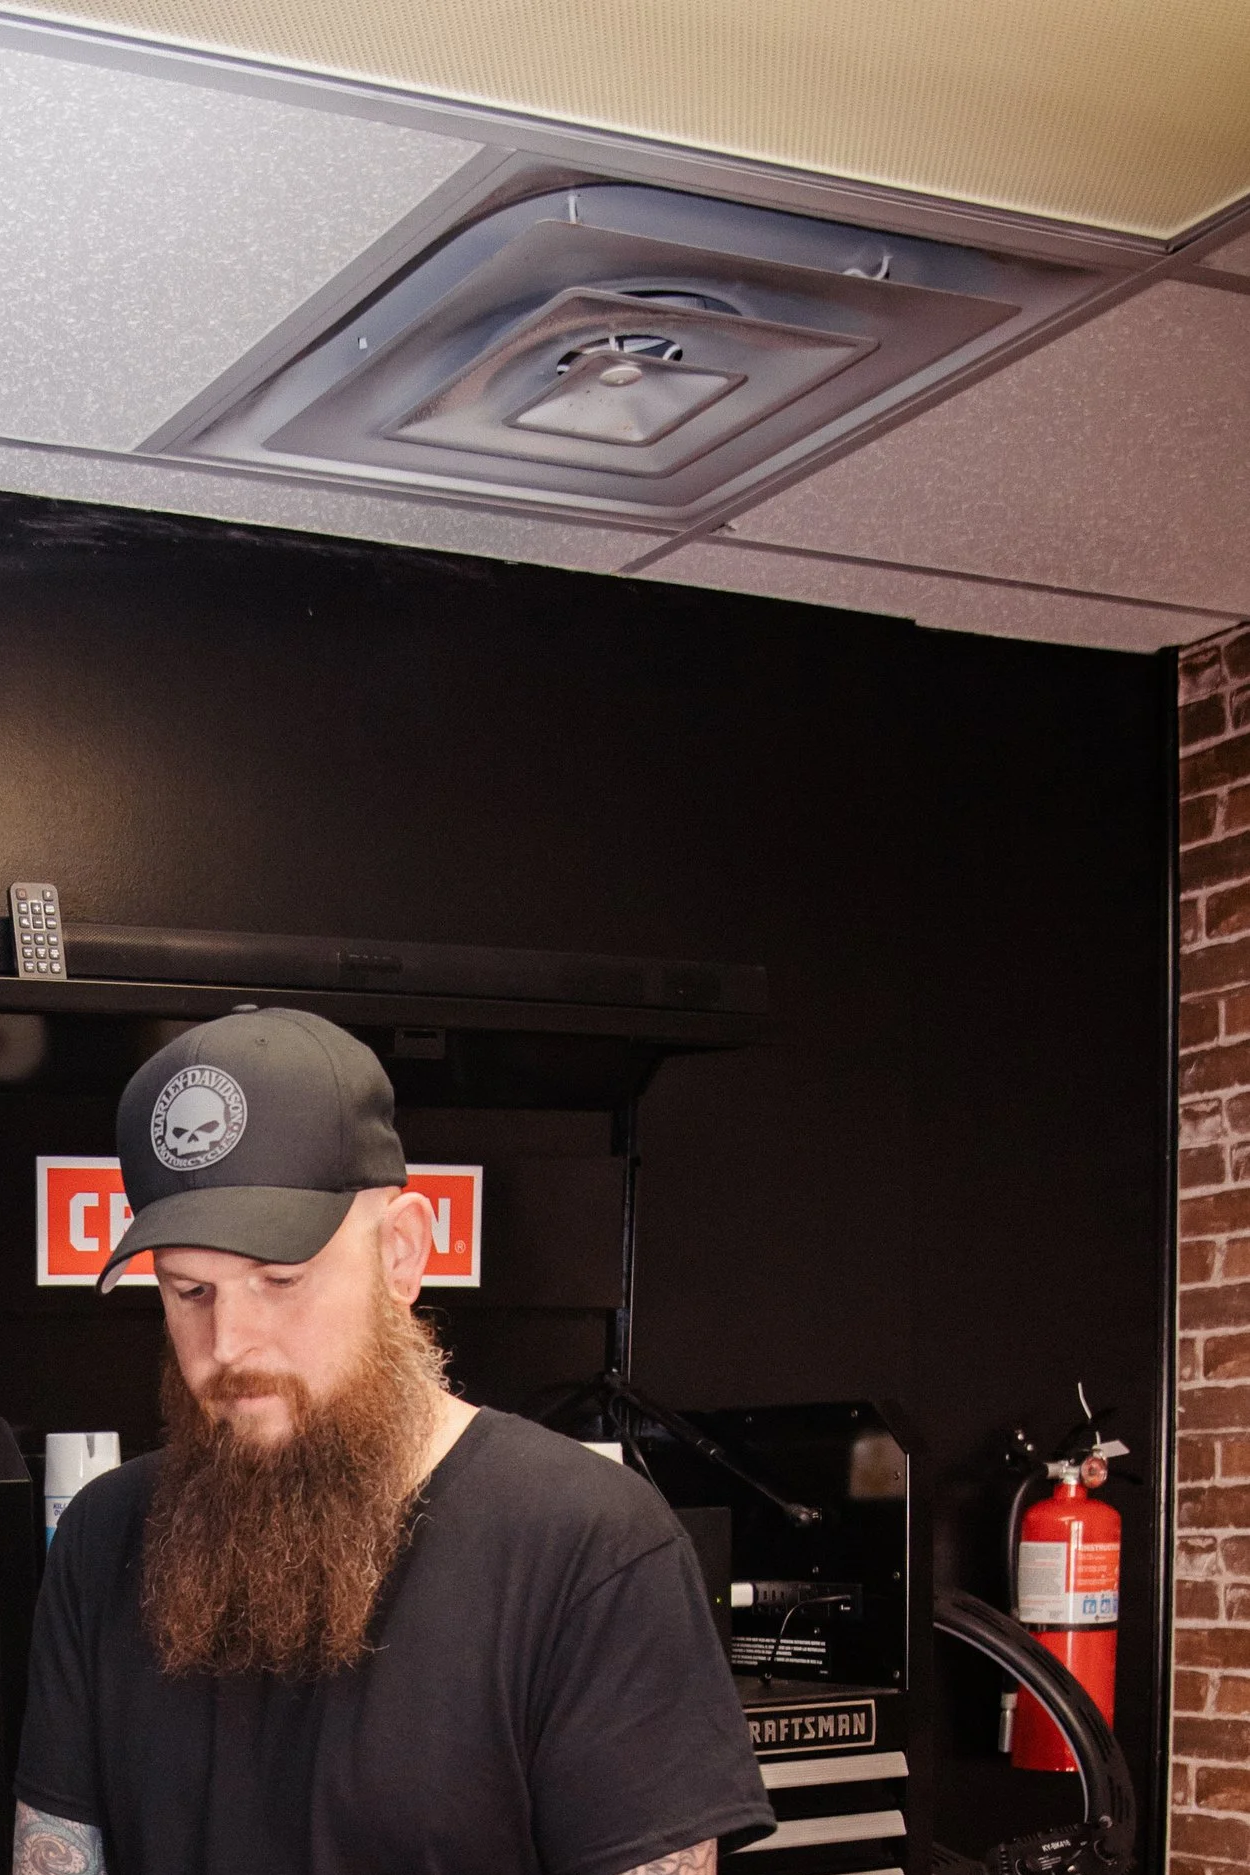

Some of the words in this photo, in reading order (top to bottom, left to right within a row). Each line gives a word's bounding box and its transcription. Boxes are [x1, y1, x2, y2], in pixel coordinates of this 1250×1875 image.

[154, 1069, 243, 1136] HARLEY-DAVIDSON
[157, 1131, 238, 1167] MOTORCYCLES
[748, 1711, 867, 1744] RAFTSMAN
